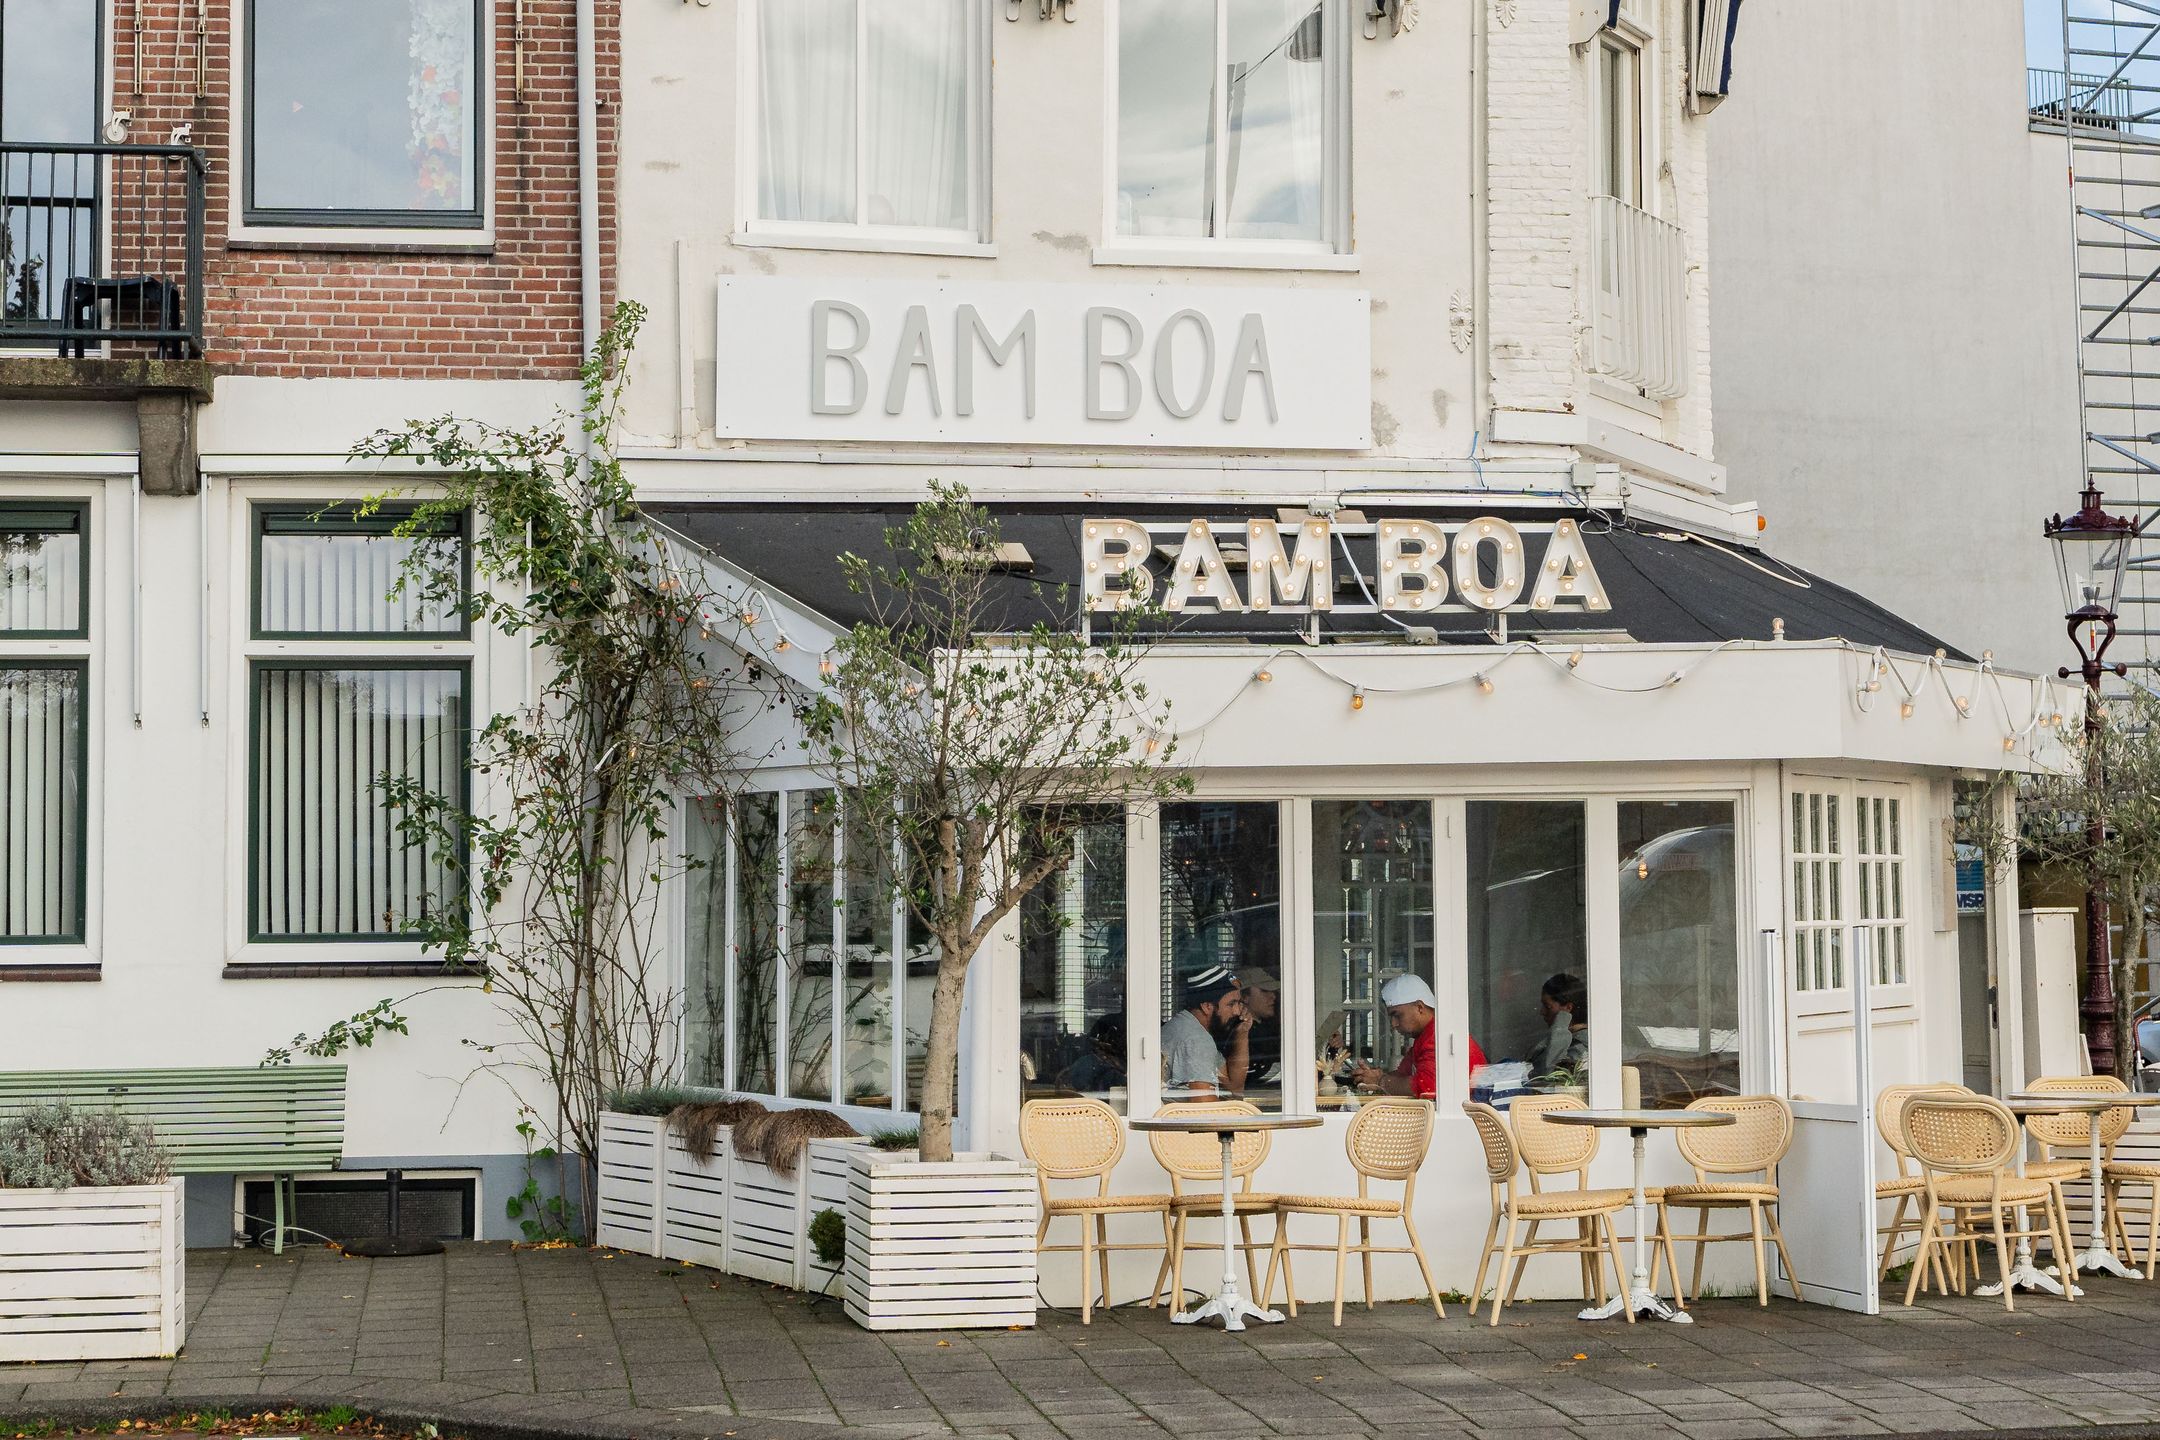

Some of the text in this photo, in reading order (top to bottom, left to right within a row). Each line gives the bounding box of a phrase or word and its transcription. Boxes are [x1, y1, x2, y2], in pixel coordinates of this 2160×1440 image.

[811, 299, 1279, 424] BAM BOA
[1081, 516, 1613, 613] BAM BOA
